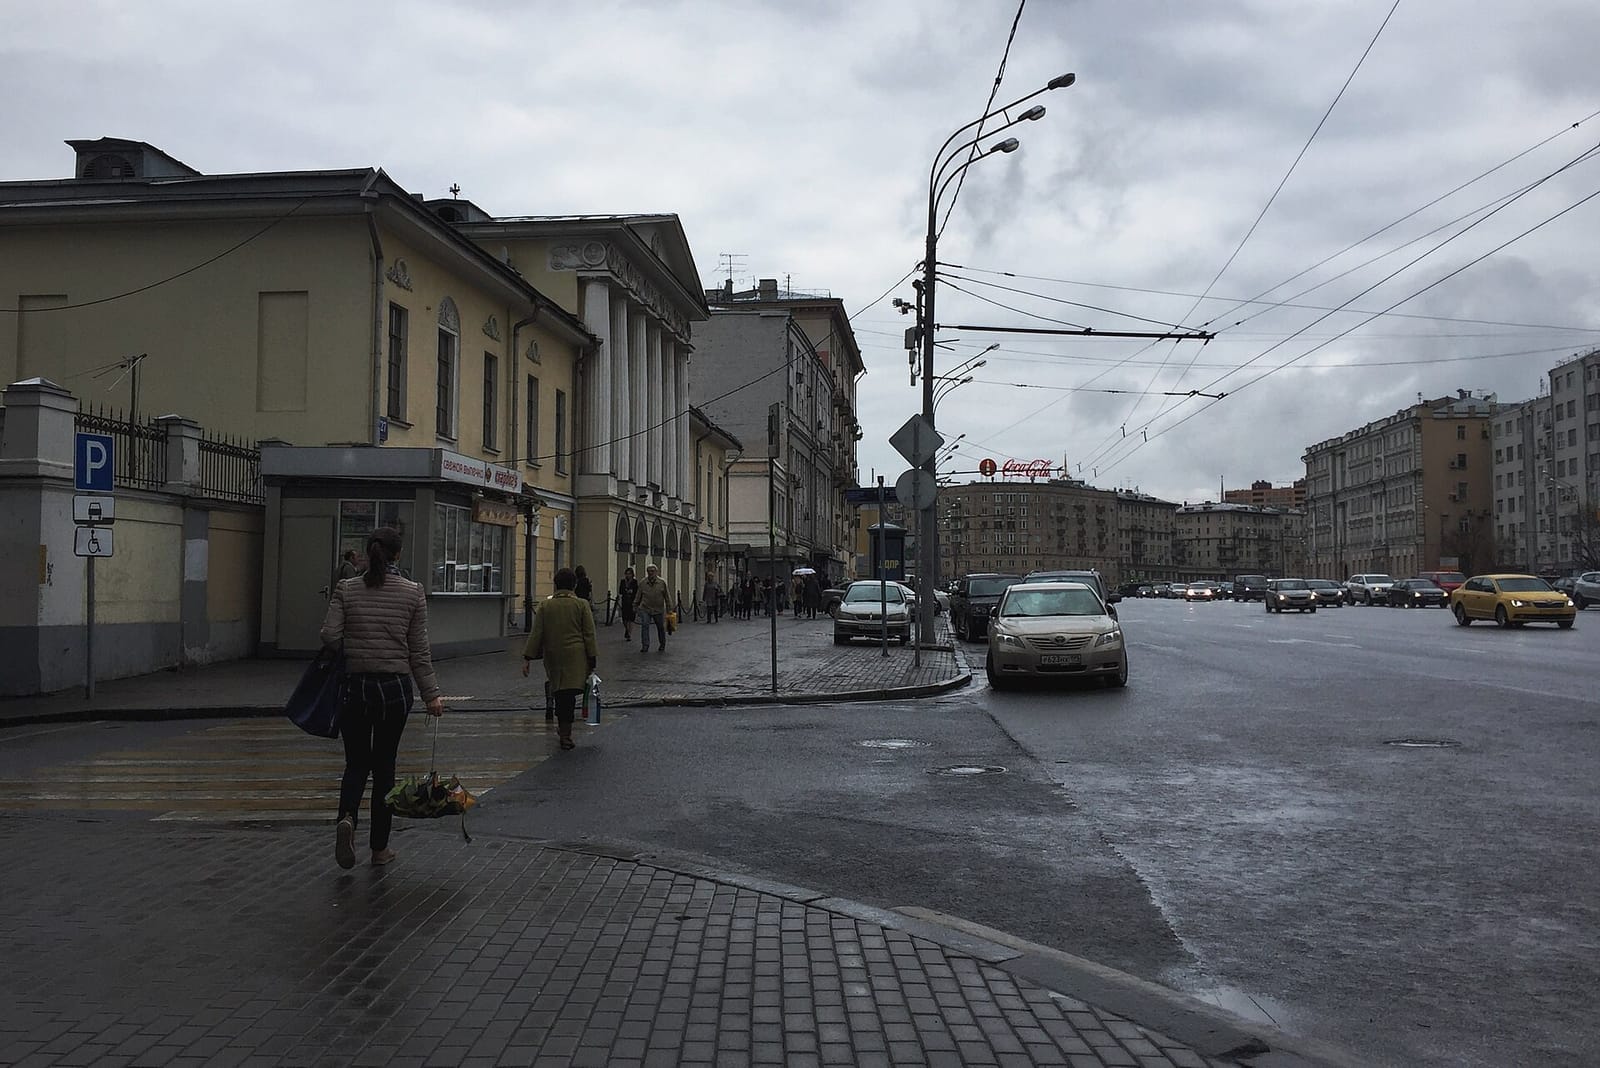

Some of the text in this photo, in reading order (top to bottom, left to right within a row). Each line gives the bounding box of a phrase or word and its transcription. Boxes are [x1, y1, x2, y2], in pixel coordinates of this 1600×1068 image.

[380, 421, 387, 433] 27
[86, 440, 107, 484] P
[1002, 458, 1053, 477] Coca-Cola
